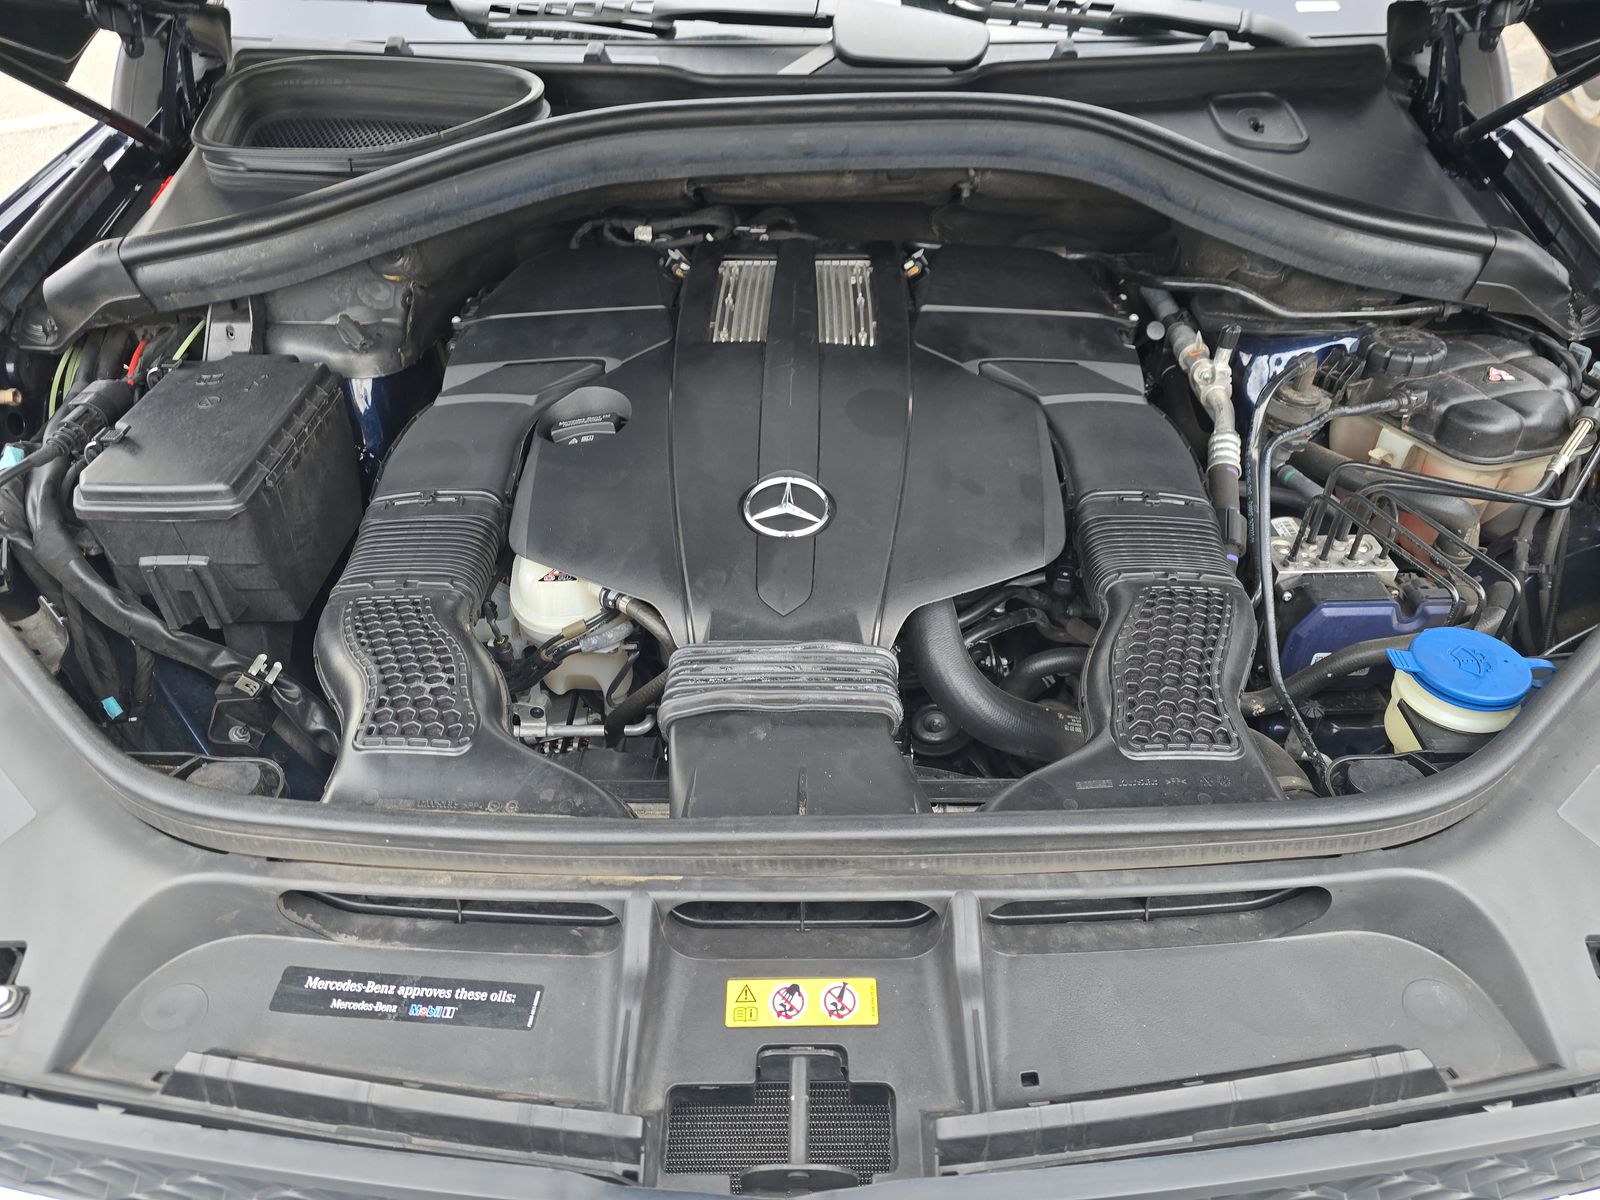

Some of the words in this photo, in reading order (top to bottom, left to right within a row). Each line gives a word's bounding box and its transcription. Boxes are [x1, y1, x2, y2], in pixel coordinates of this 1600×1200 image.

[304, 975, 396, 995] Mercedes-Benz
[396, 985, 453, 999] approves
[454, 987, 489, 1001] these
[489, 990, 517, 1004] oils:
[329, 997, 398, 1013] Mercedes-Benz
[408, 1003, 443, 1018] Mobil
